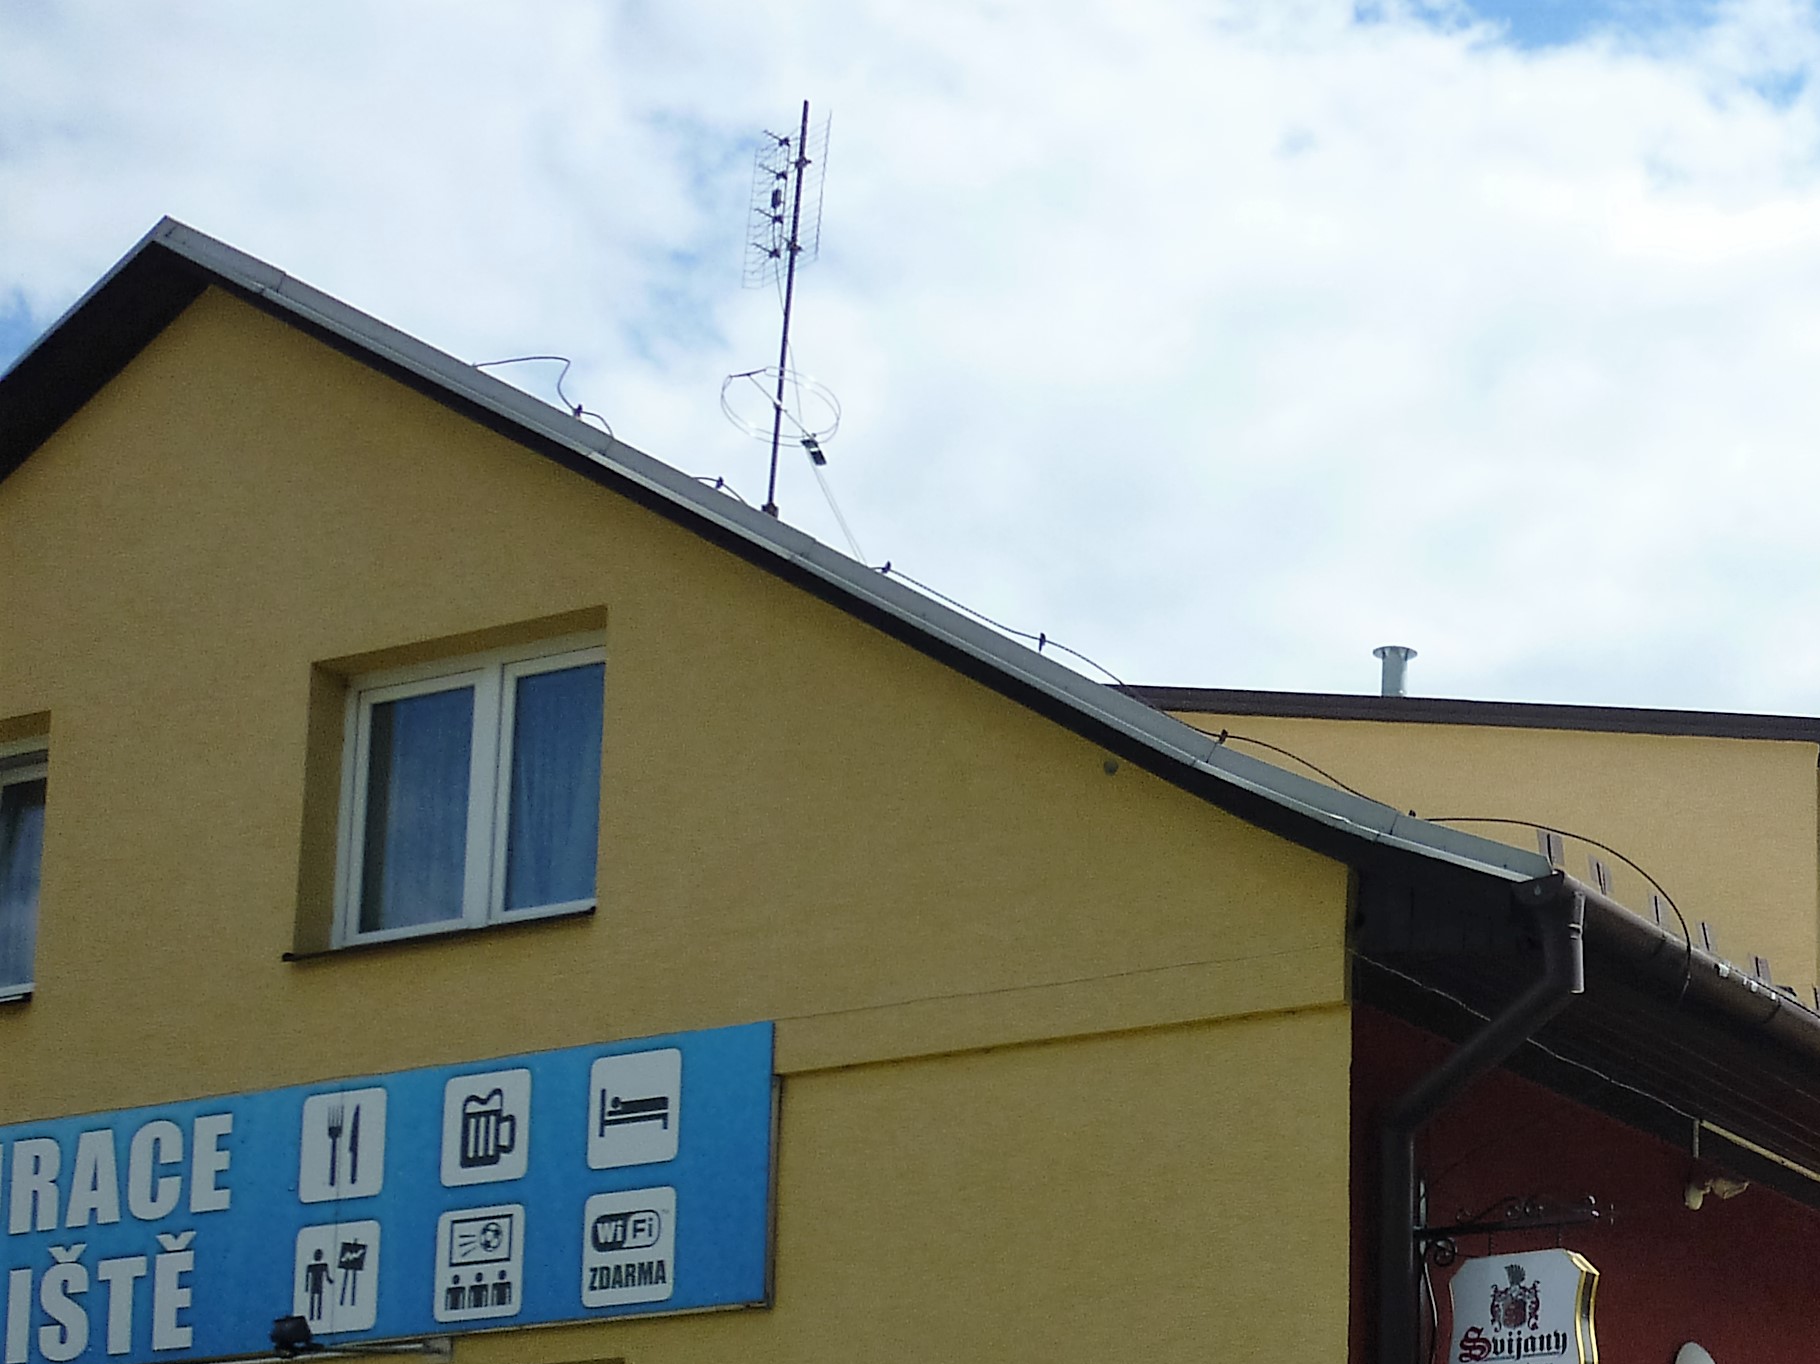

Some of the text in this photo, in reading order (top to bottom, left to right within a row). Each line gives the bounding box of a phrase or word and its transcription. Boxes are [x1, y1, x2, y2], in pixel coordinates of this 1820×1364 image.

[0, 1112, 233, 1235] RACE
[5, 1231, 196, 1364] IŠTĚ
[589, 1260, 666, 1291] ZDARMA
[1459, 1326, 1568, 1363] Svijany
